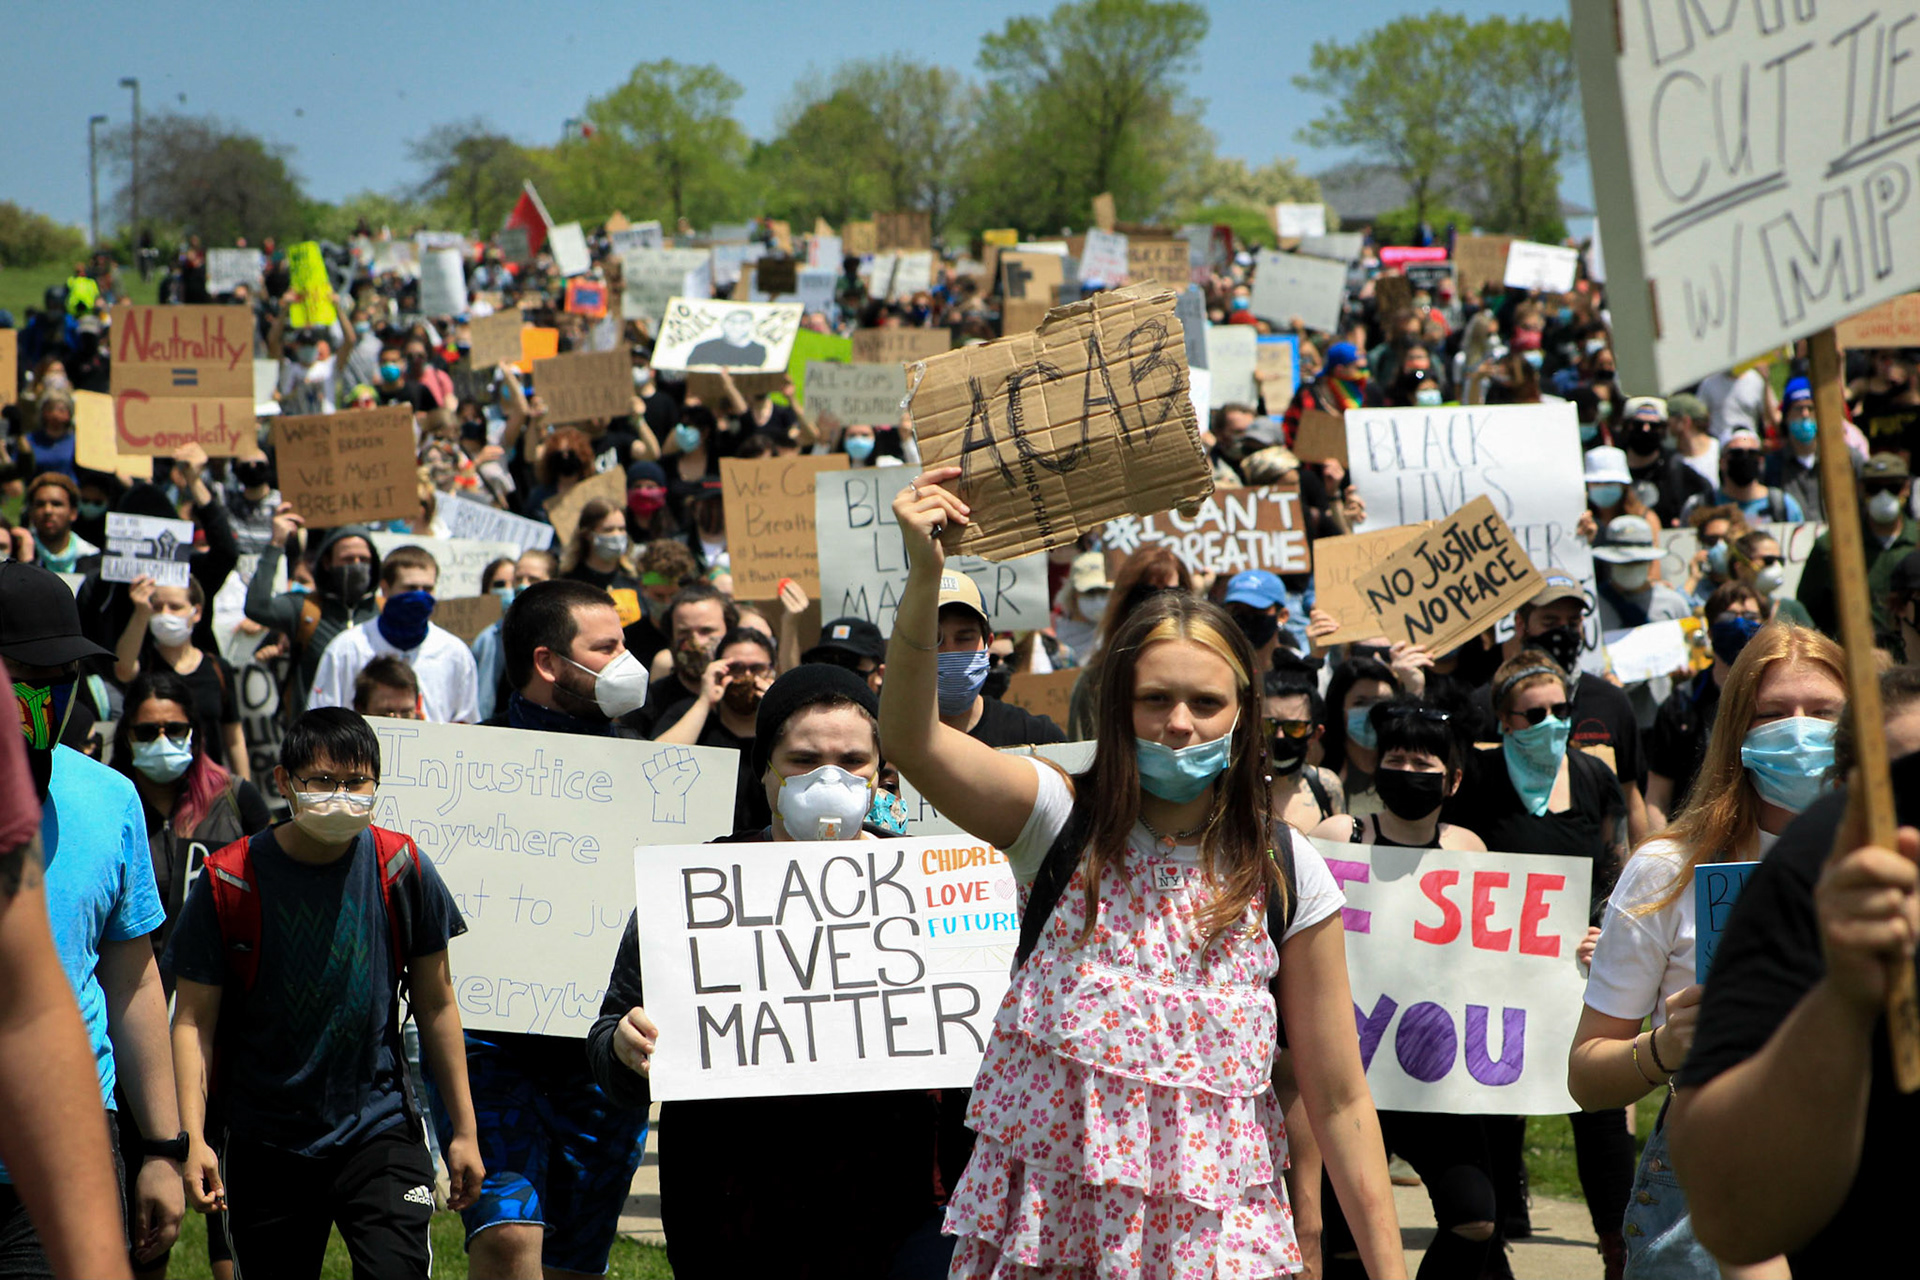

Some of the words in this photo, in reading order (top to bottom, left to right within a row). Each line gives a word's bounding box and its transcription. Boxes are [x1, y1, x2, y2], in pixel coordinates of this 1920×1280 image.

[1650, 42, 1814, 203] CUT
[1759, 158, 1920, 329] MP
[118, 309, 247, 370] Neutrality
[116, 389, 241, 451] Complicity
[280, 421, 331, 444] WHEN
[958, 312, 1184, 497] ACAB
[1363, 410, 1494, 473] BLACK
[296, 490, 364, 518] BREAK
[374, 485, 395, 509] IT
[298, 465, 334, 487] WE
[343, 461, 390, 483] MUST
[729, 465, 770, 499] We
[1031, 492, 1044, 503] A
[1033, 504, 1054, 538] WITH
[1168, 486, 1299, 534] CAN'T
[1367, 567, 1414, 615] NO
[1404, 599, 1449, 645] NO
[1443, 547, 1530, 621] PEACE
[377, 726, 614, 817] Injustice
[373, 796, 601, 865] Anywhere
[920, 844, 1010, 877] CHIDRE
[509, 883, 553, 926] to
[681, 849, 917, 931] BLACK
[925, 879, 991, 909] LOVE
[1158, 875, 1181, 888] NY
[1413, 869, 1567, 958] SEE
[689, 915, 926, 996] LIVES
[696, 981, 986, 1071] MATTER
[1353, 992, 1528, 1088] YOU
